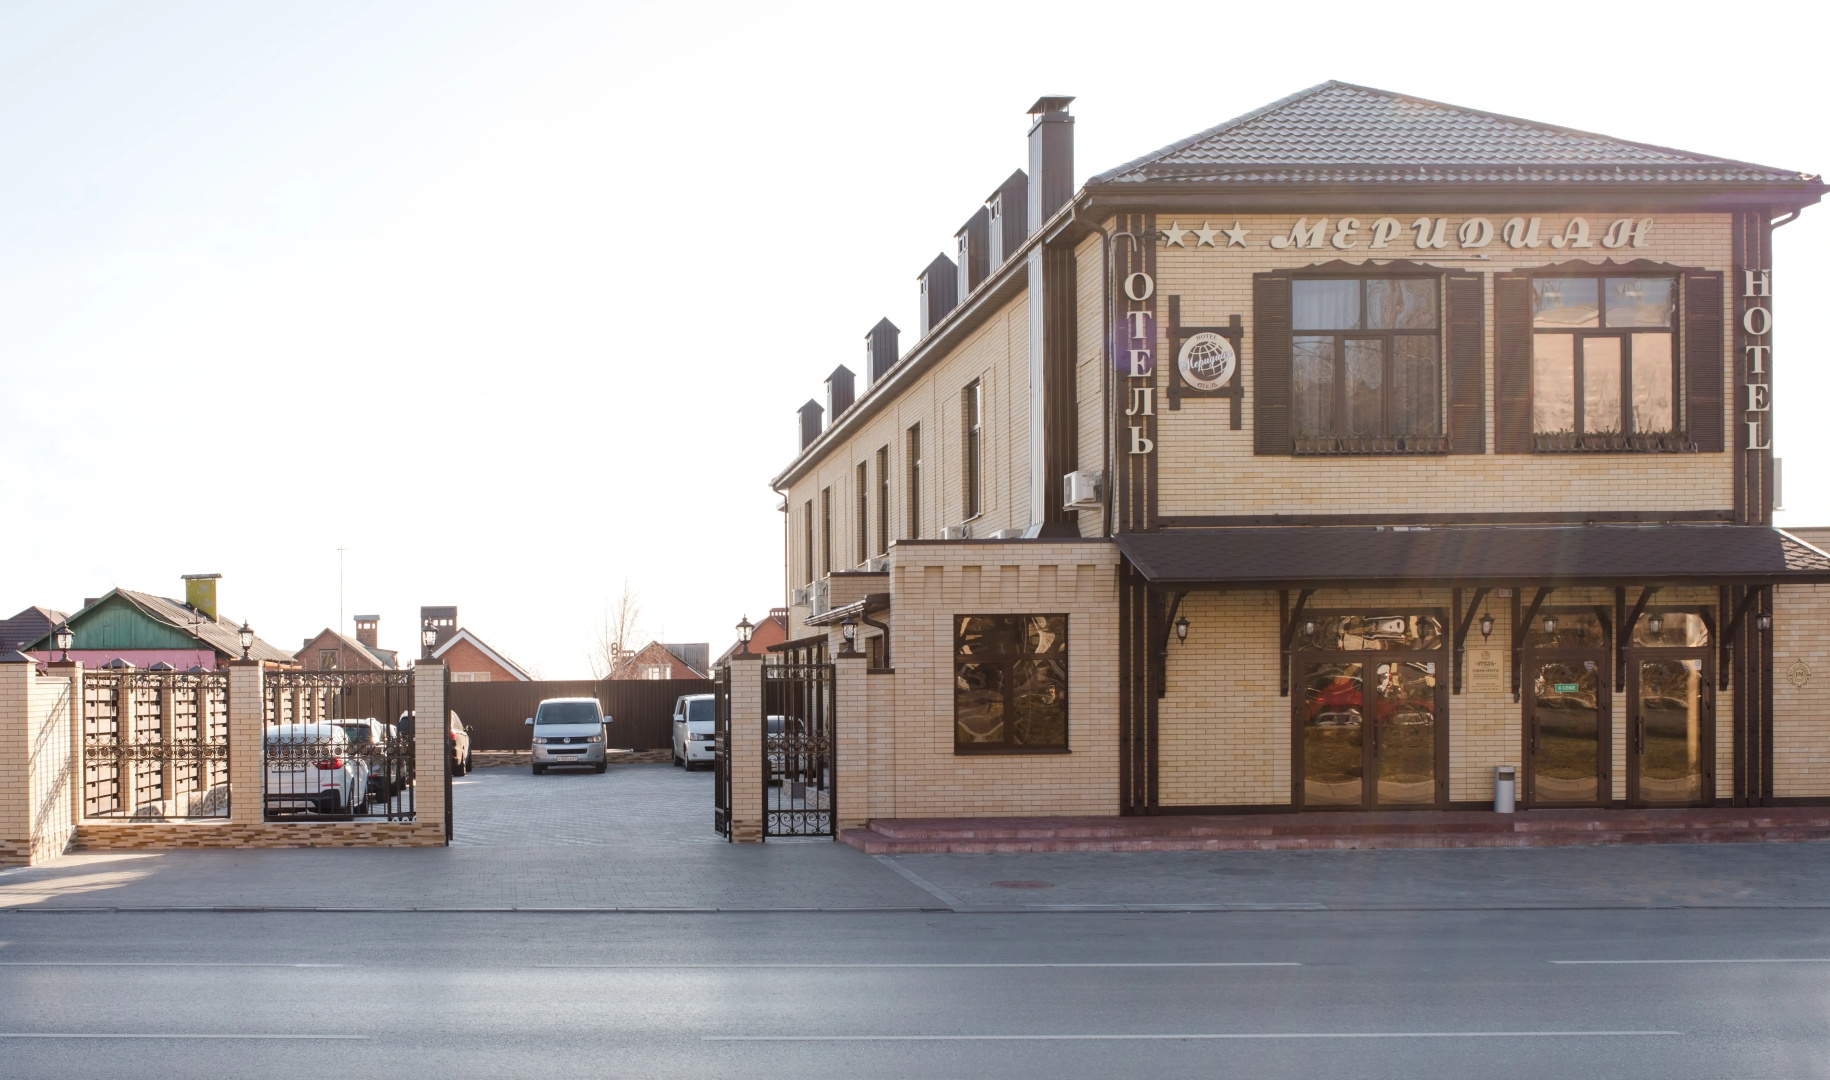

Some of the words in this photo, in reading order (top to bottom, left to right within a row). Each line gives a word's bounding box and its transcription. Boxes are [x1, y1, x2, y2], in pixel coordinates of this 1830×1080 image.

[1271, 217, 1654, 249] МЕРИДИАН
[1124, 272, 1155, 455] ОТЕЛЬ
[1743, 269, 1772, 450] HOTEL
